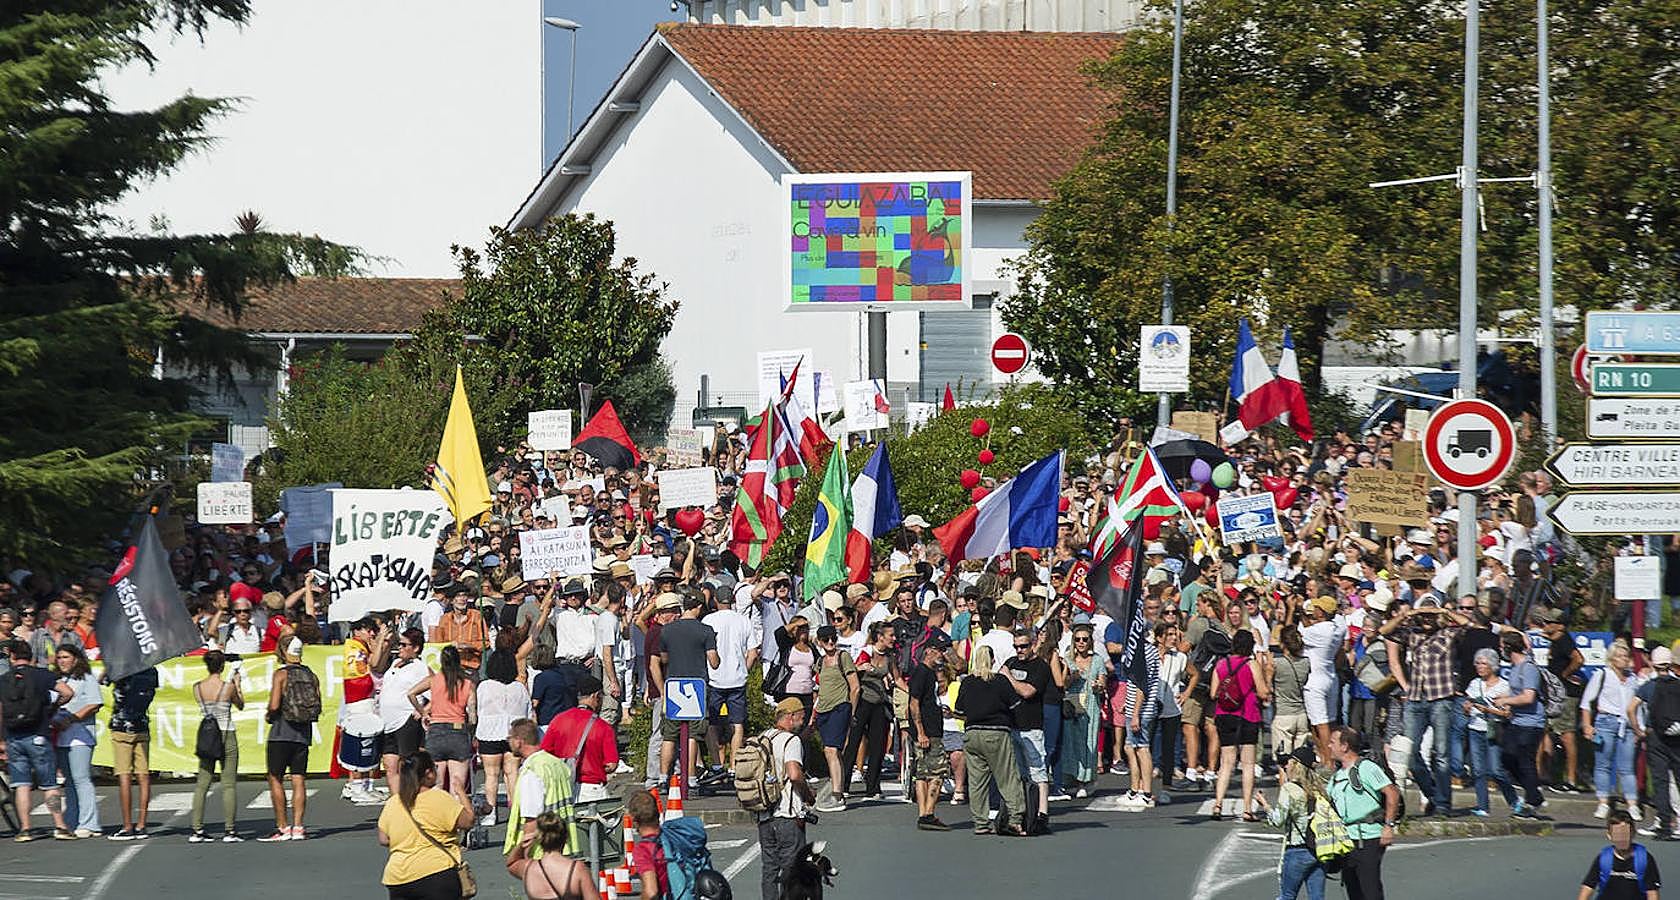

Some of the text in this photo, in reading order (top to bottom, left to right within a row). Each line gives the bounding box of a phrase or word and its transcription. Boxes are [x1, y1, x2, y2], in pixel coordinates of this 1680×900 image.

[797, 185, 961, 209] EGUIAZABAL
[793, 221, 846, 239] Cave
[862, 220, 887, 238] vin
[1598, 371, 1652, 388] RN 10
[1623, 404, 1651, 415] Zone
[1655, 405, 1669, 415] de
[1573, 450, 1679, 462] CENTRE VILLE
[1574, 467, 1607, 479] HIRI
[203, 503, 249, 516] LIBERTE
[115, 577, 158, 655] RÉSISTONS
